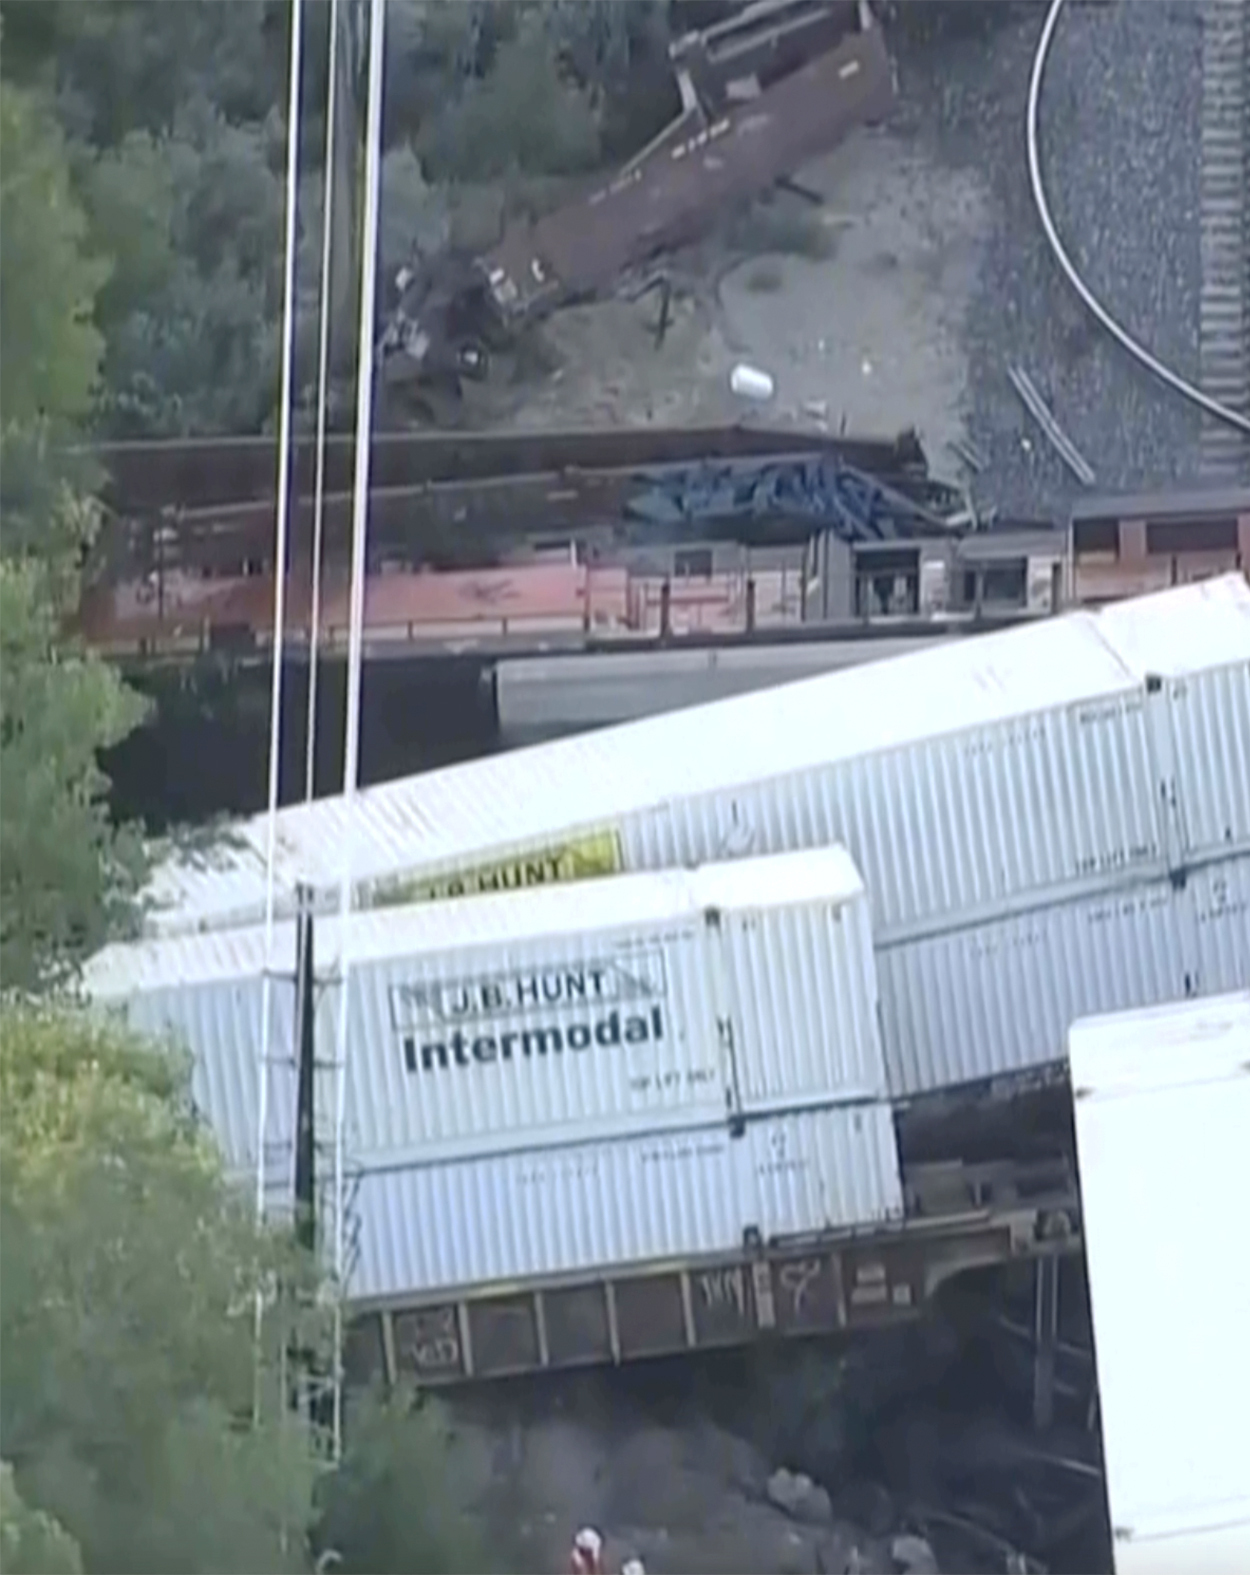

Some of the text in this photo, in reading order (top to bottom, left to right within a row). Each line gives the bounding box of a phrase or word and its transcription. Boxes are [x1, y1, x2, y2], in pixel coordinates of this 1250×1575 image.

[452, 969, 604, 1014] J.B. HUNT
[403, 1004, 664, 1073] Intermodal
